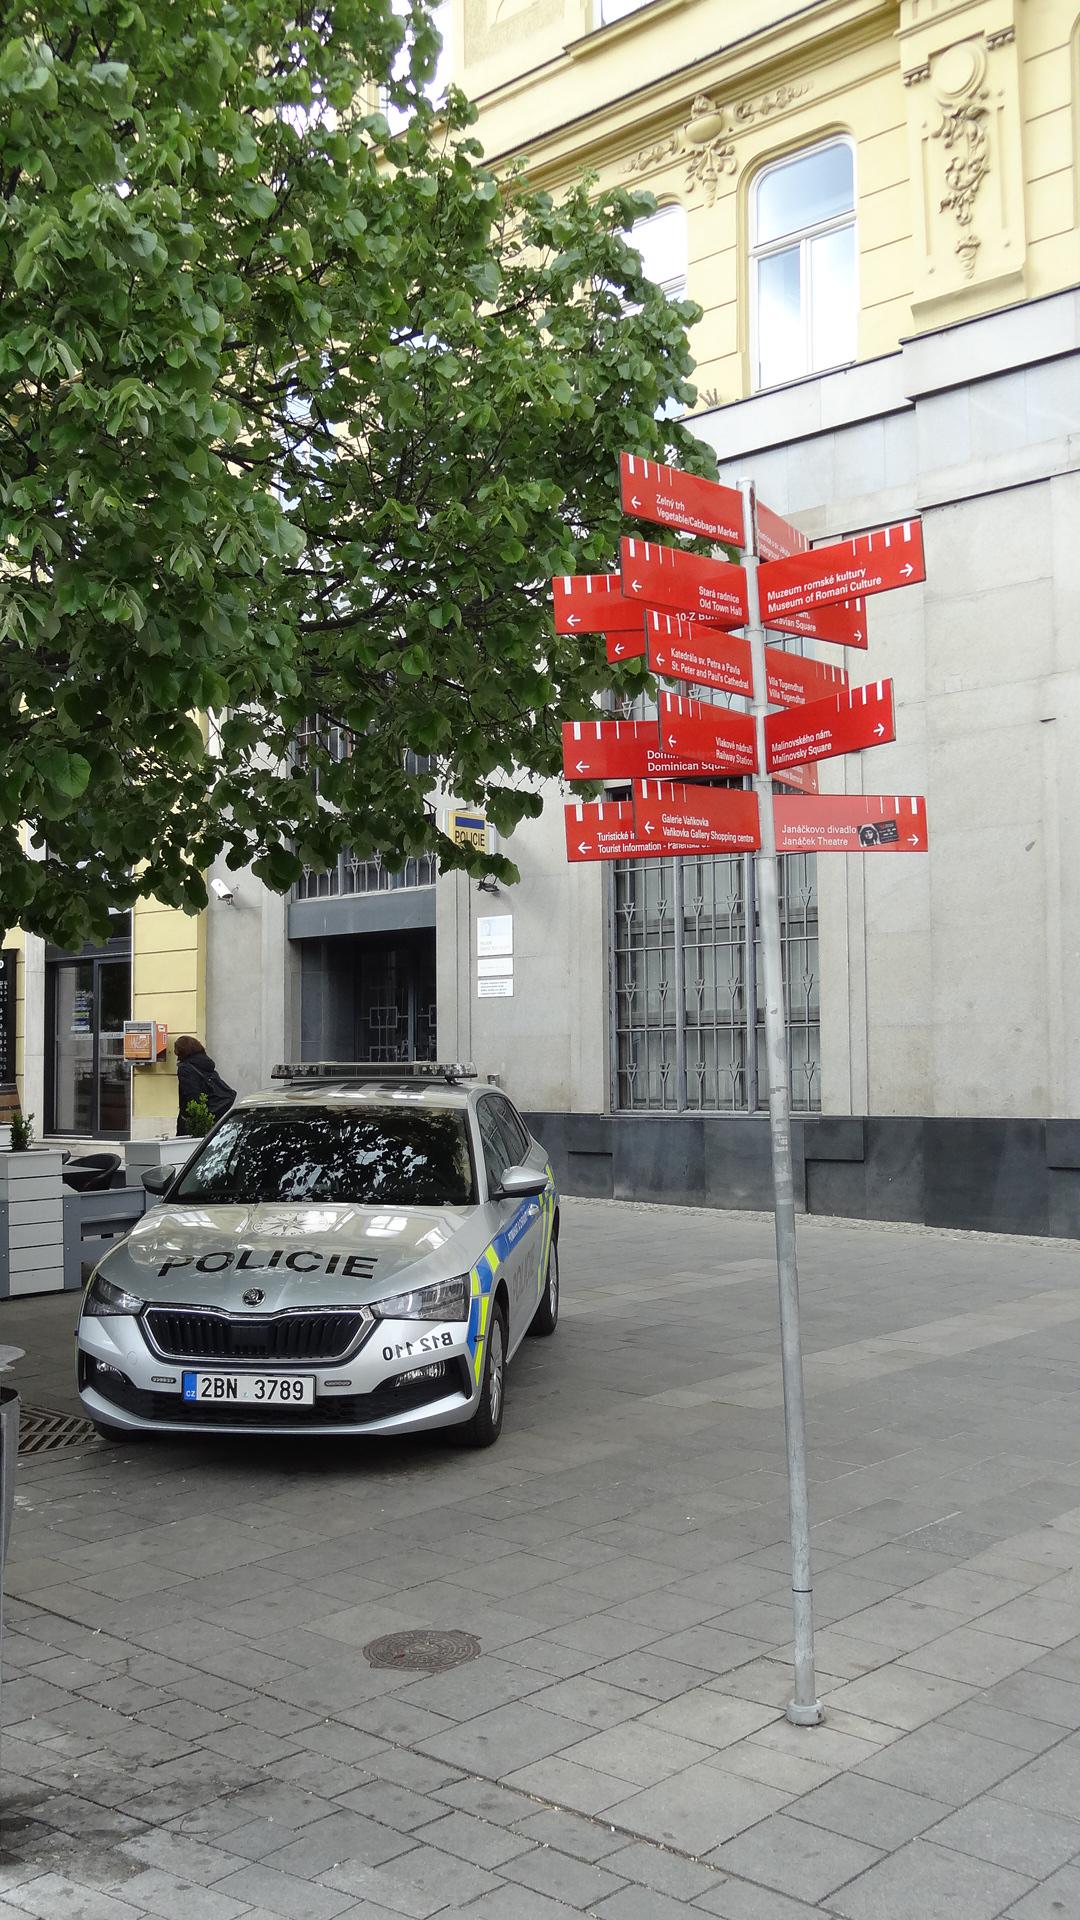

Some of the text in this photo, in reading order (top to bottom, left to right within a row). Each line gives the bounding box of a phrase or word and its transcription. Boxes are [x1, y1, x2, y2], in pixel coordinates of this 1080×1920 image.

[656, 494, 685, 512] Zelný trh
[717, 525, 739, 540] Market
[767, 568, 867, 601] Muzeum romské kultury
[698, 585, 740, 604] Stará radnice
[768, 577, 882, 613] Museum of Romani Culture
[700, 598, 743, 617] Old Town Hall
[795, 619, 817, 632] Square
[671, 648, 741, 675] Katedrála sv. Petra a Pavla
[671, 660, 749, 689] St. Peter and Paul's Cathedral
[715, 736, 735, 750] Vlakové
[771, 729, 833, 752] Malinovského nám.
[716, 749, 753, 766] Railway Station
[772, 743, 832, 765] Malinovsky Square
[647, 762, 699, 772] Dominican
[661, 813, 709, 827] Galerie Vaňkovka
[597, 831, 629, 842] Turistické
[662, 826, 754, 844] Vaňkovka Gallery Shopping centre
[782, 825, 857, 834] Janáčkovo divadlo
[597, 844, 621, 854] Tourist
[622, 841, 661, 852] Information
[782, 837, 848, 846] Janáček Theatre
[158, 1250, 378, 1279] POLICIE
[185, 1390, 196, 1398] CZ
[201, 1377, 304, 1401] 2BN 3789
